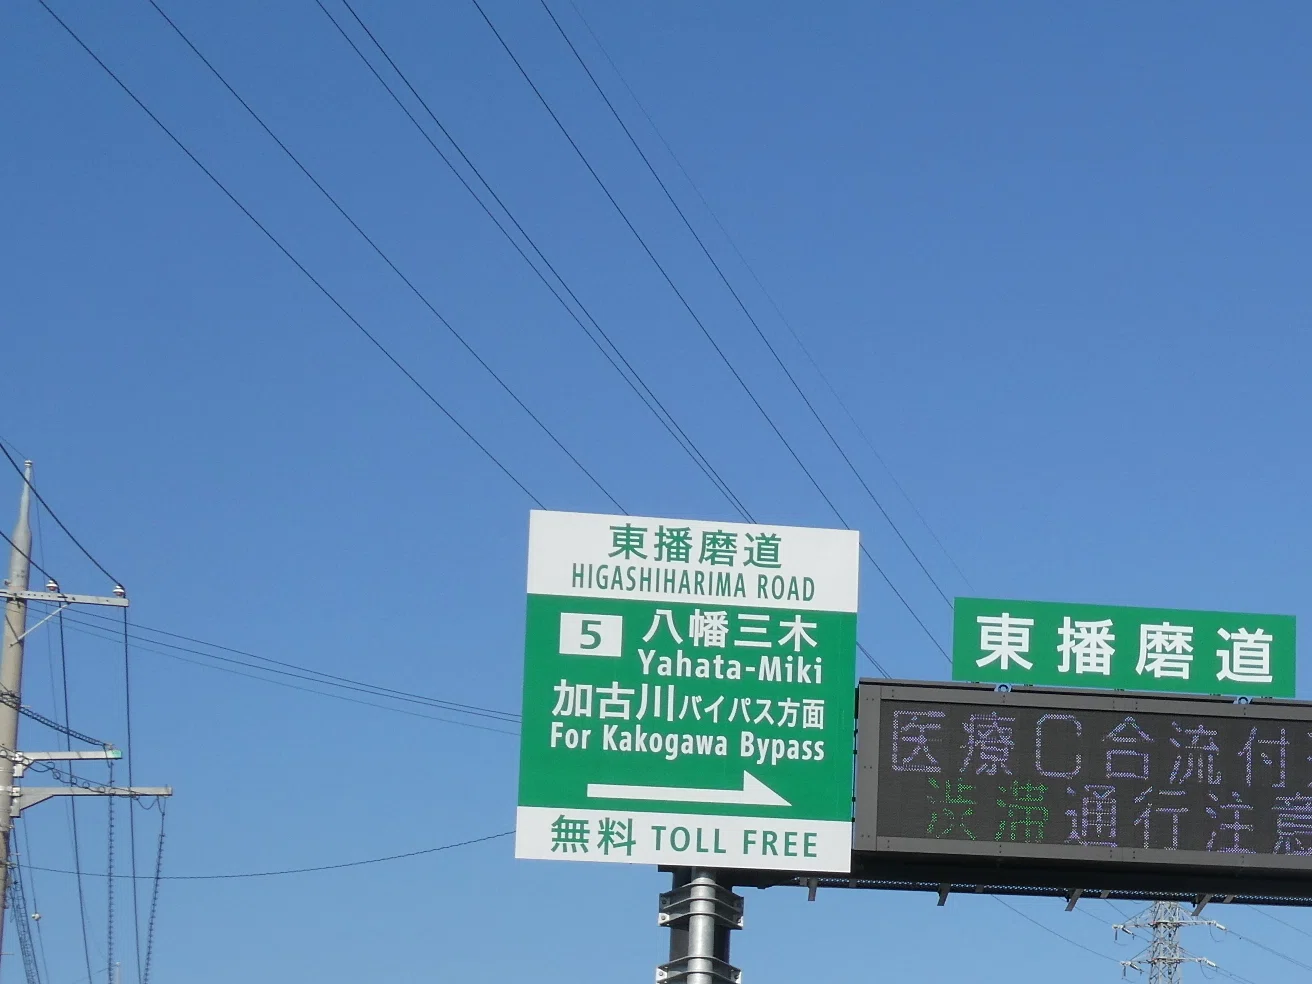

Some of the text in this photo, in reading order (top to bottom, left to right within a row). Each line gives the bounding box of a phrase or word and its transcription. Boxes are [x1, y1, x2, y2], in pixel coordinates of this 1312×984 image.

[608, 523, 782, 569] 東播磨道
[572, 563, 815, 602] HIGASHIHARIMA ROAD
[579, 619, 602, 650] 5
[642, 608, 818, 652] 八幡三木
[974, 612, 1273, 684] 東播磨道
[637, 649, 822, 684] Yahata-Miki
[550, 722, 825, 765] For Kakogawa Bypass
[550, 814, 637, 857] 無料
[651, 825, 818, 858] TOLL FREE
